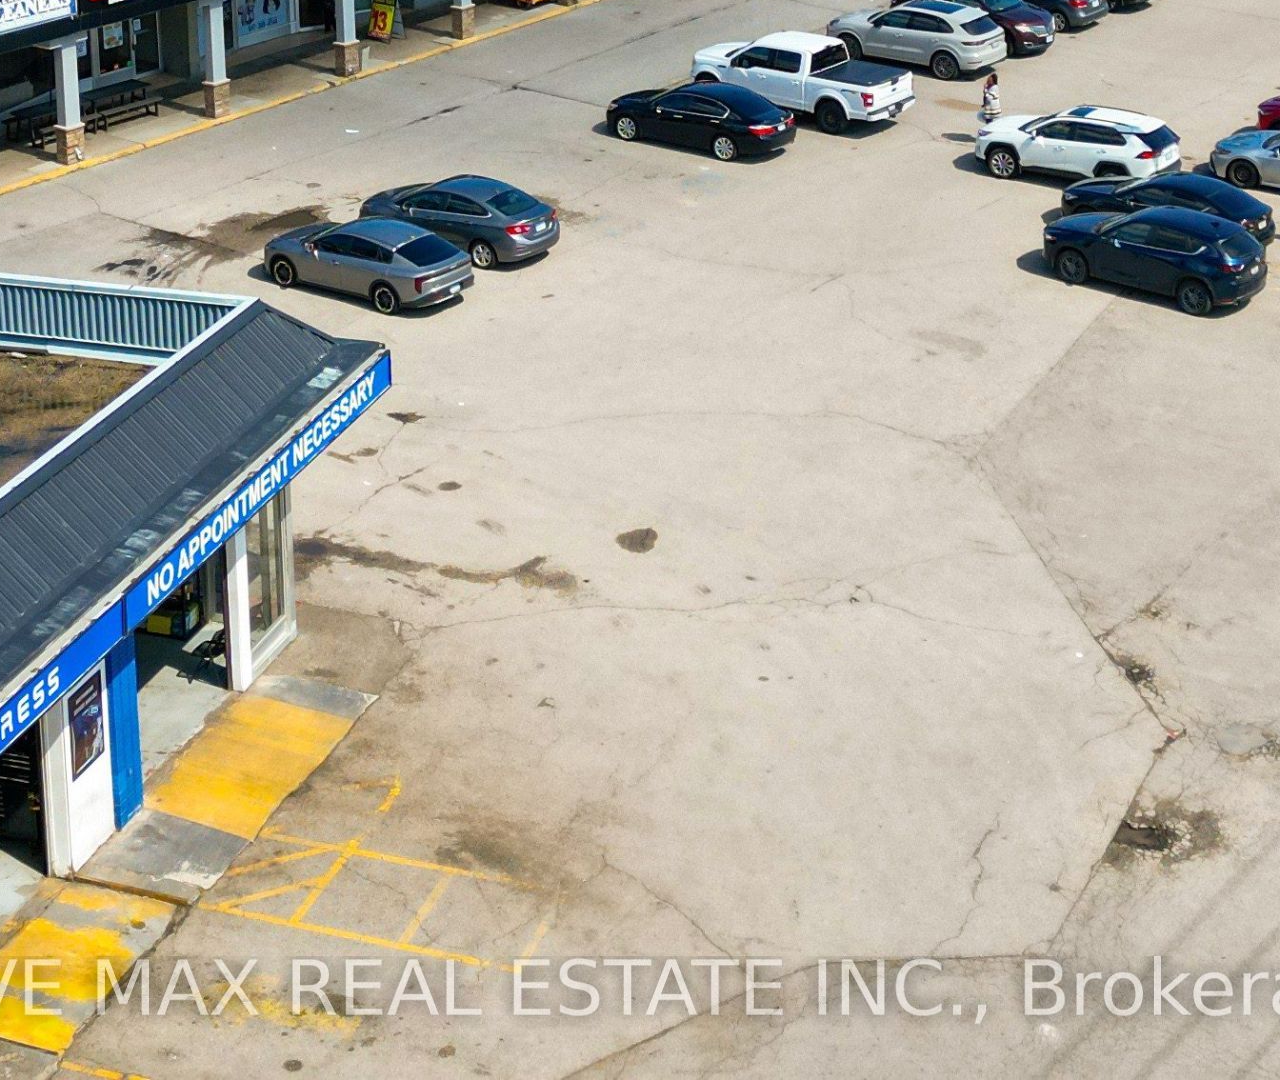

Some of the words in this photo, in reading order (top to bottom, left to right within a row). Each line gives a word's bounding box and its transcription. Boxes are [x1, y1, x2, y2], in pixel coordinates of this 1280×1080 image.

[146, 562, 175, 606] NO
[176, 450, 290, 579] APPOINTMENT
[291, 371, 376, 468] NECESSARY
